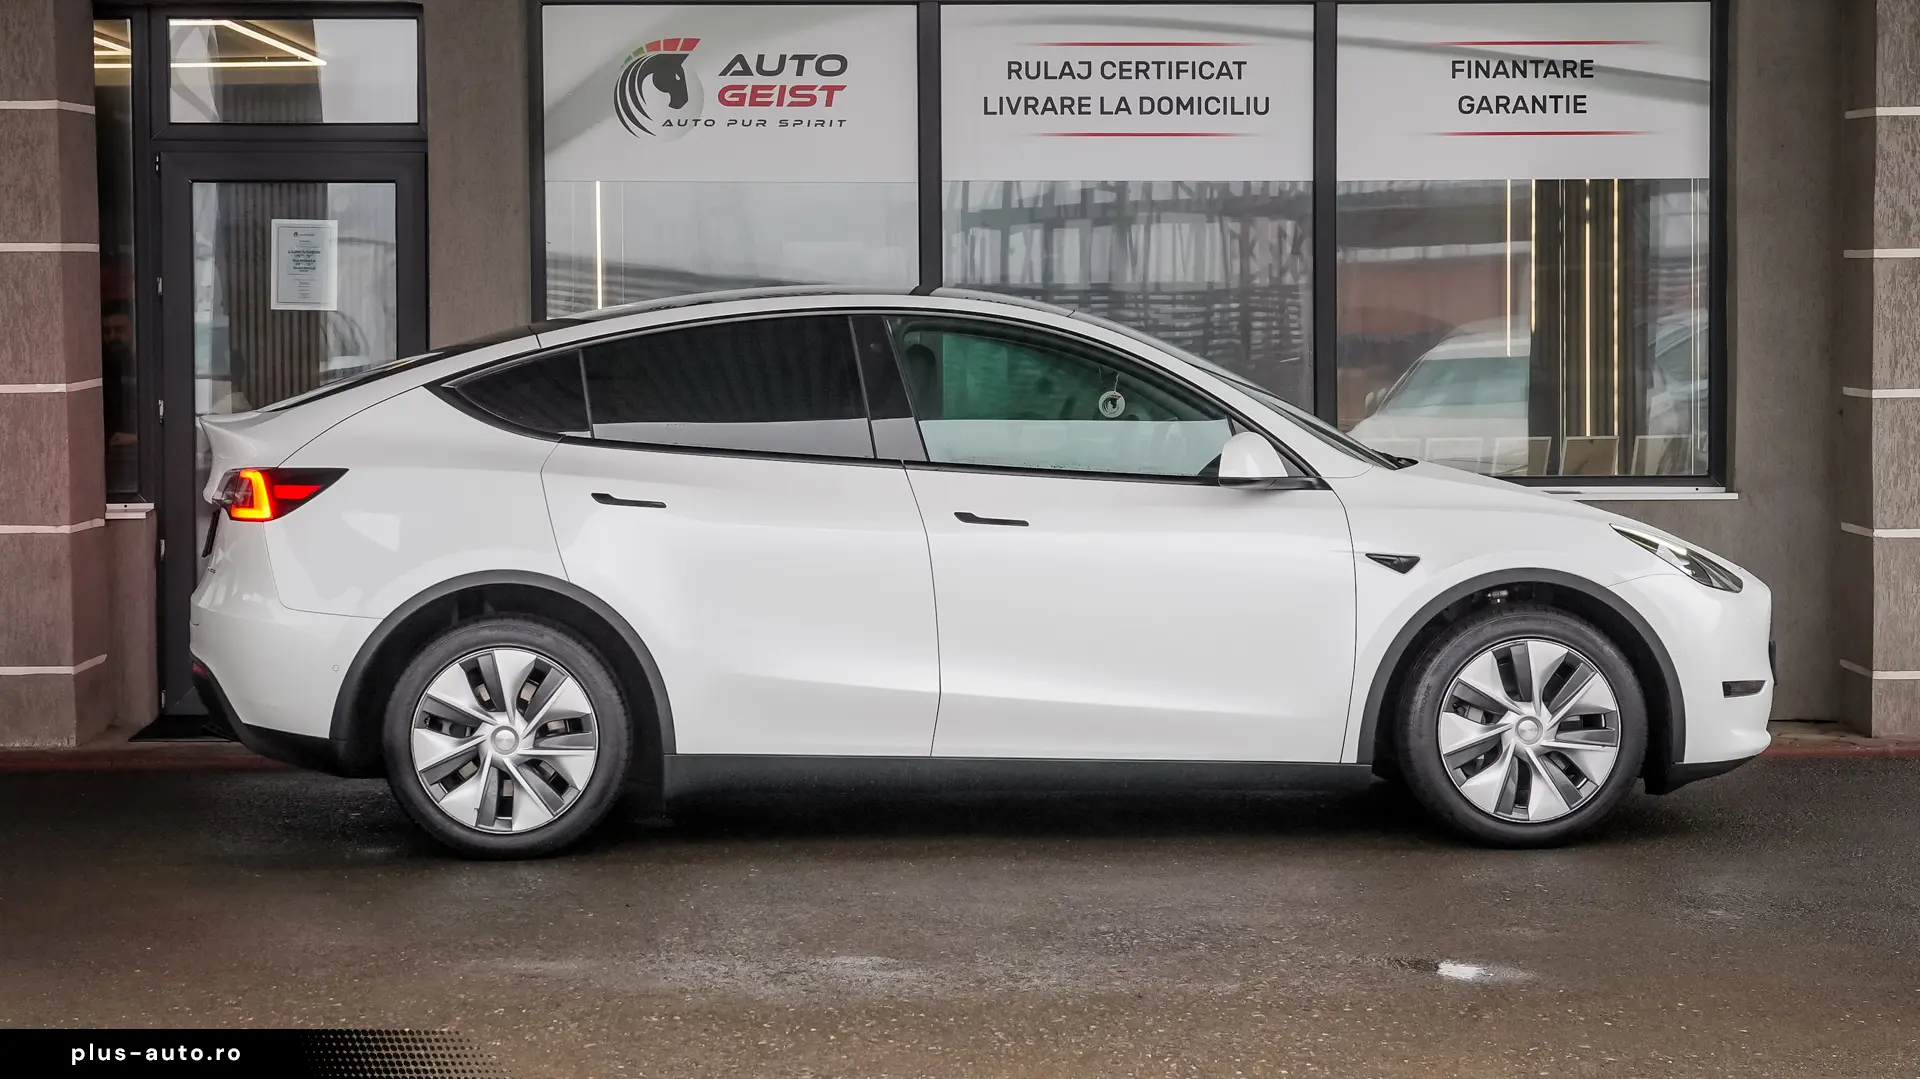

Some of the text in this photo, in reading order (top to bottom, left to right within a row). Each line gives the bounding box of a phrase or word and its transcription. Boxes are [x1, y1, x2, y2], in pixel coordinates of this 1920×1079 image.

[718, 54, 848, 77] AUTO
[1007, 61, 1248, 80] RULAJ CERTIFICAT
[1451, 60, 1595, 79] FINANTARE
[718, 85, 847, 107] GEIST
[983, 96, 1270, 116] LIVRARE LA DOMICILIU
[1458, 95, 1588, 115] GARANTIE
[661, 119, 847, 128] AUTO PUR SPIRIT
